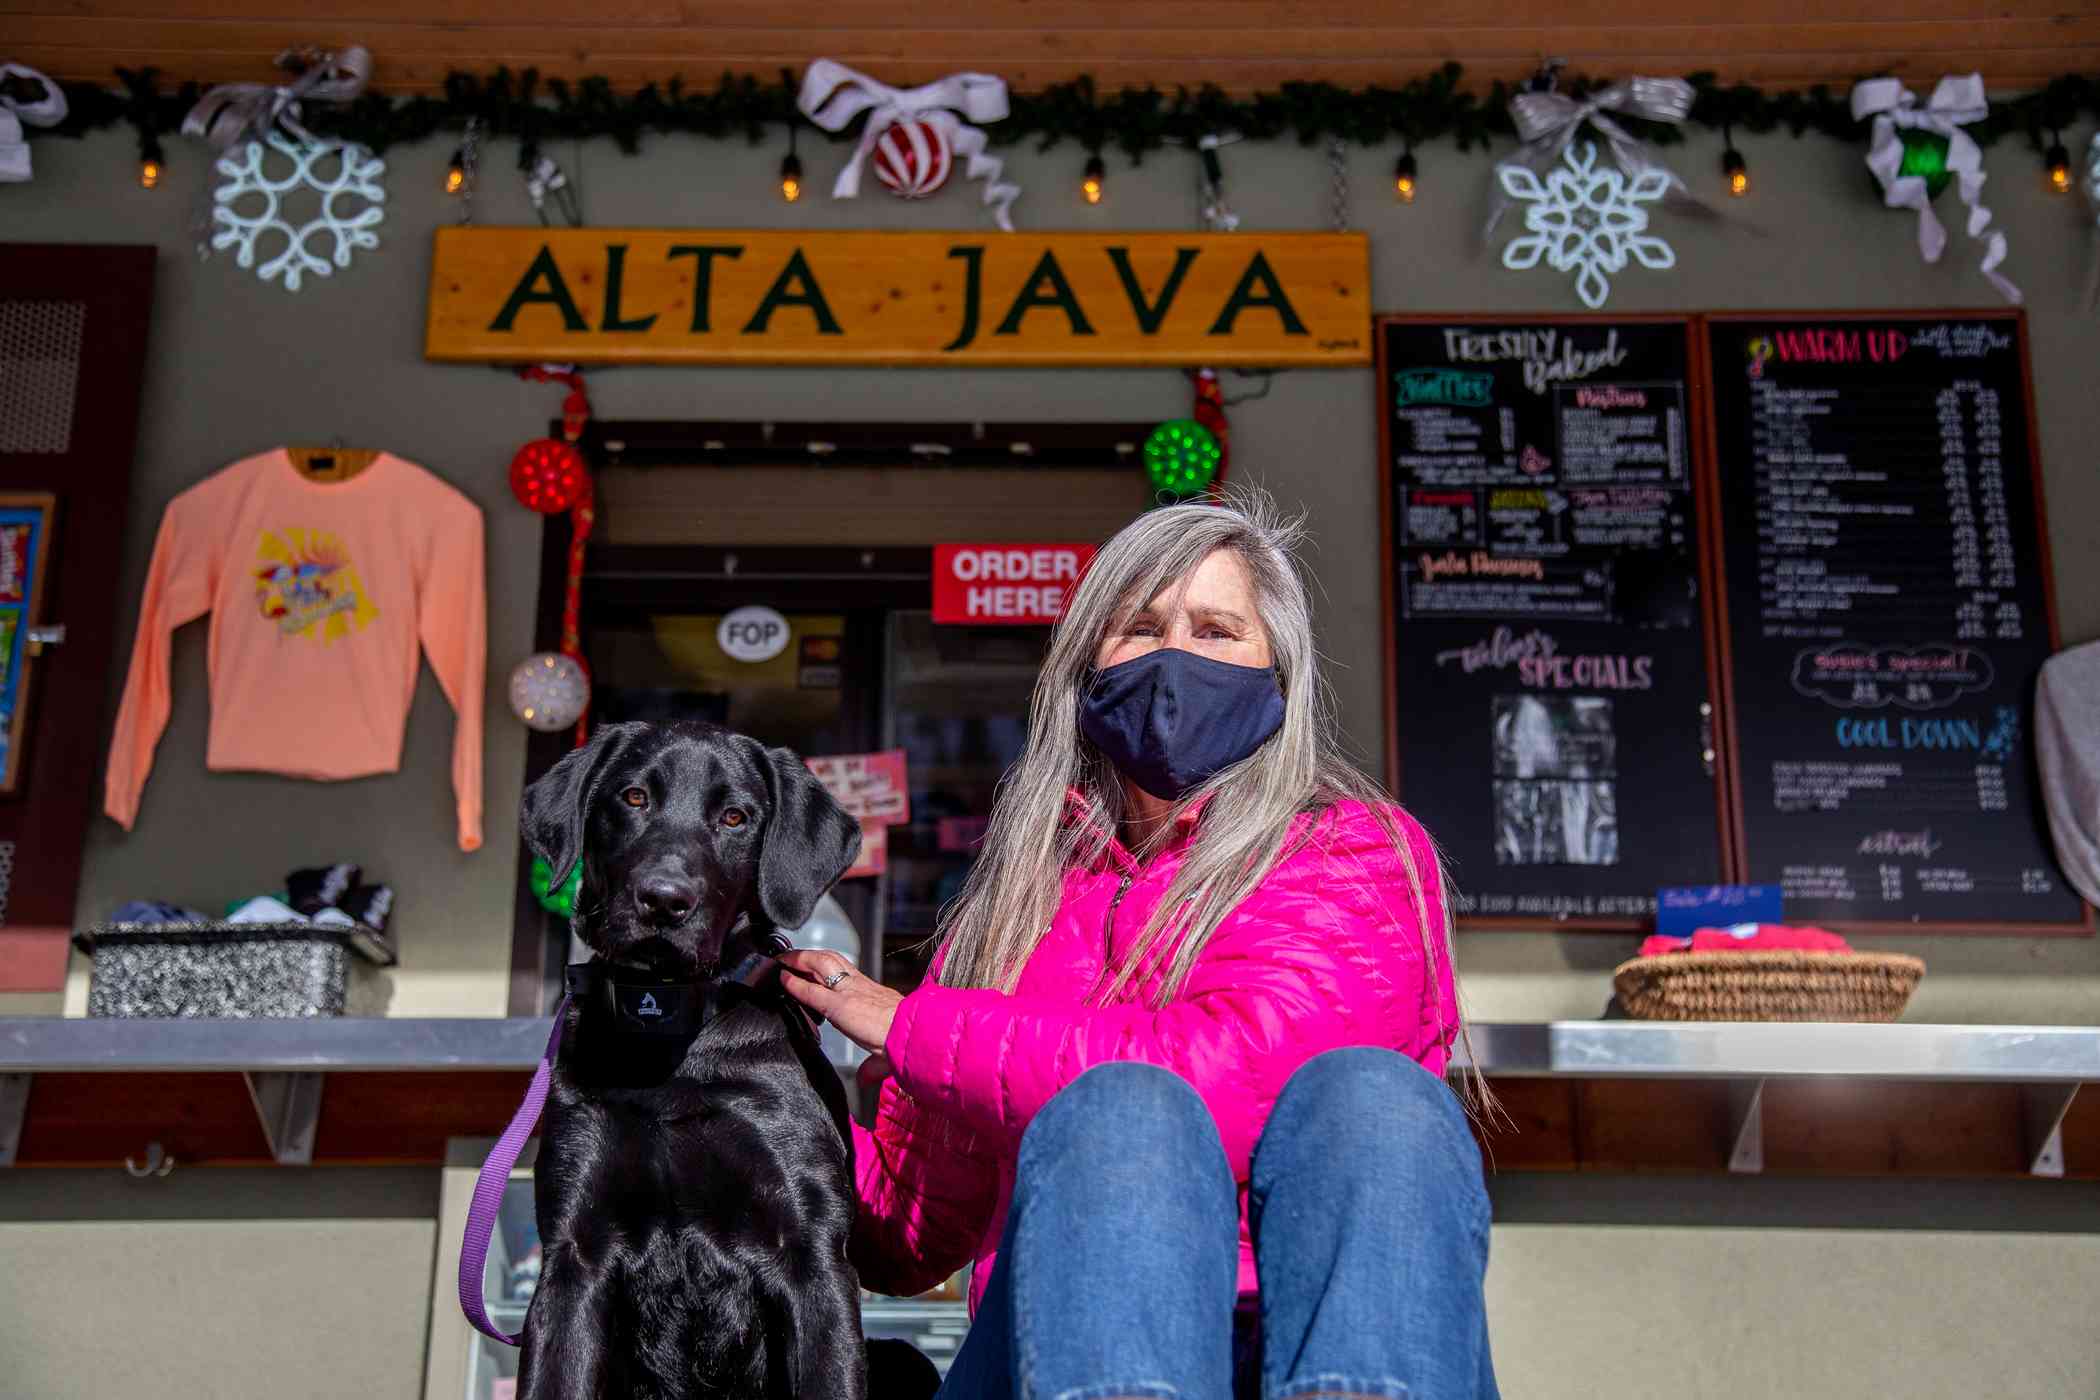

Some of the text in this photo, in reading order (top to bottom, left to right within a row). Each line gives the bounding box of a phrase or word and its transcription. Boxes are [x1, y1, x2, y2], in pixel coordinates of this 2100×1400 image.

[488, 245, 1308, 351] ALTA JAVA
[1774, 327, 1862, 364] WARM
[1865, 326, 1911, 365] UP
[952, 550, 1078, 581] ORDER
[967, 586, 1064, 617] HERE
[727, 621, 780, 645] FOP
[1519, 654, 1654, 691] SPECIALS
[1900, 717, 1981, 752] DOWN
